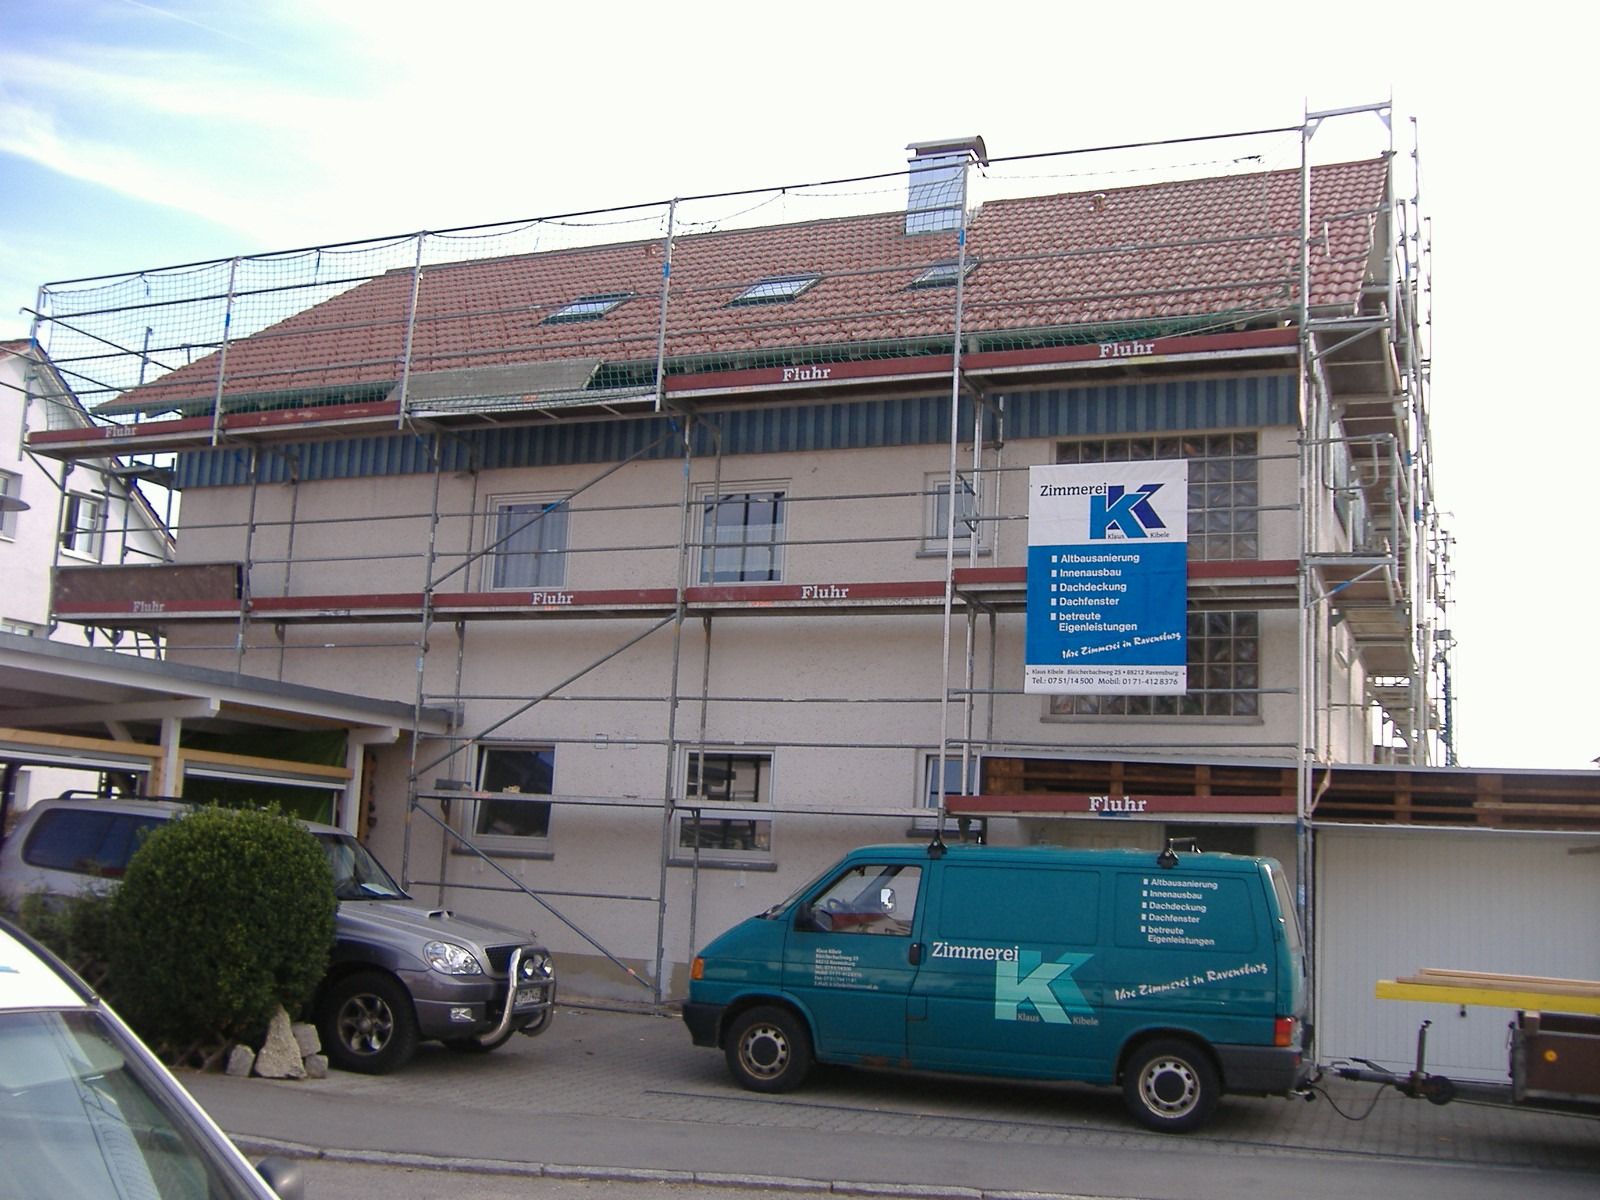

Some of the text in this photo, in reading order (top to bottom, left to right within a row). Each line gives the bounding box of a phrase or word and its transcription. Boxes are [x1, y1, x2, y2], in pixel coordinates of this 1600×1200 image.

[1099, 341, 1155, 358] Fluhr
[782, 366, 831, 382] Fluhr
[105, 426, 137, 438] Fluhr
[1040, 482, 1107, 497] Zimmerei
[1150, 531, 1170, 539] Kibele
[1060, 553, 1140, 564] Altbausanierung
[1060, 568, 1122, 578] Innenausbau
[801, 585, 849, 599] Fluhr
[1059, 582, 1127, 593] Dachdeckung
[532, 592, 574, 605] Fluhr
[1059, 597, 1120, 607] Dachfenster
[133, 600, 166, 612] Fluhr
[1059, 612, 1102, 622] betreute
[1058, 622, 1138, 634] Eigenleistungen
[1080, 641, 1121, 656] Zimmerei
[1121, 640, 1132, 649] in
[1133, 631, 1182, 647] Ravensburg
[1088, 795, 1147, 812] Fluhr
[1150, 878, 1218, 890] Altbausanierung
[1149, 890, 1203, 900] Innenausbau
[1149, 901, 1207, 913] Dachdeckung
[1148, 913, 1200, 923] Dachfenster
[1147, 925, 1185, 935] betreute
[1147, 934, 1216, 947] Eigenleistungen
[931, 941, 1020, 962] Zimmerei
[1138, 976, 1190, 996] Zimmerei
[1192, 974, 1205, 986] in
[1206, 962, 1269, 983] Ravensburg
[1017, 1012, 1099, 1026] Klaus Kibele
